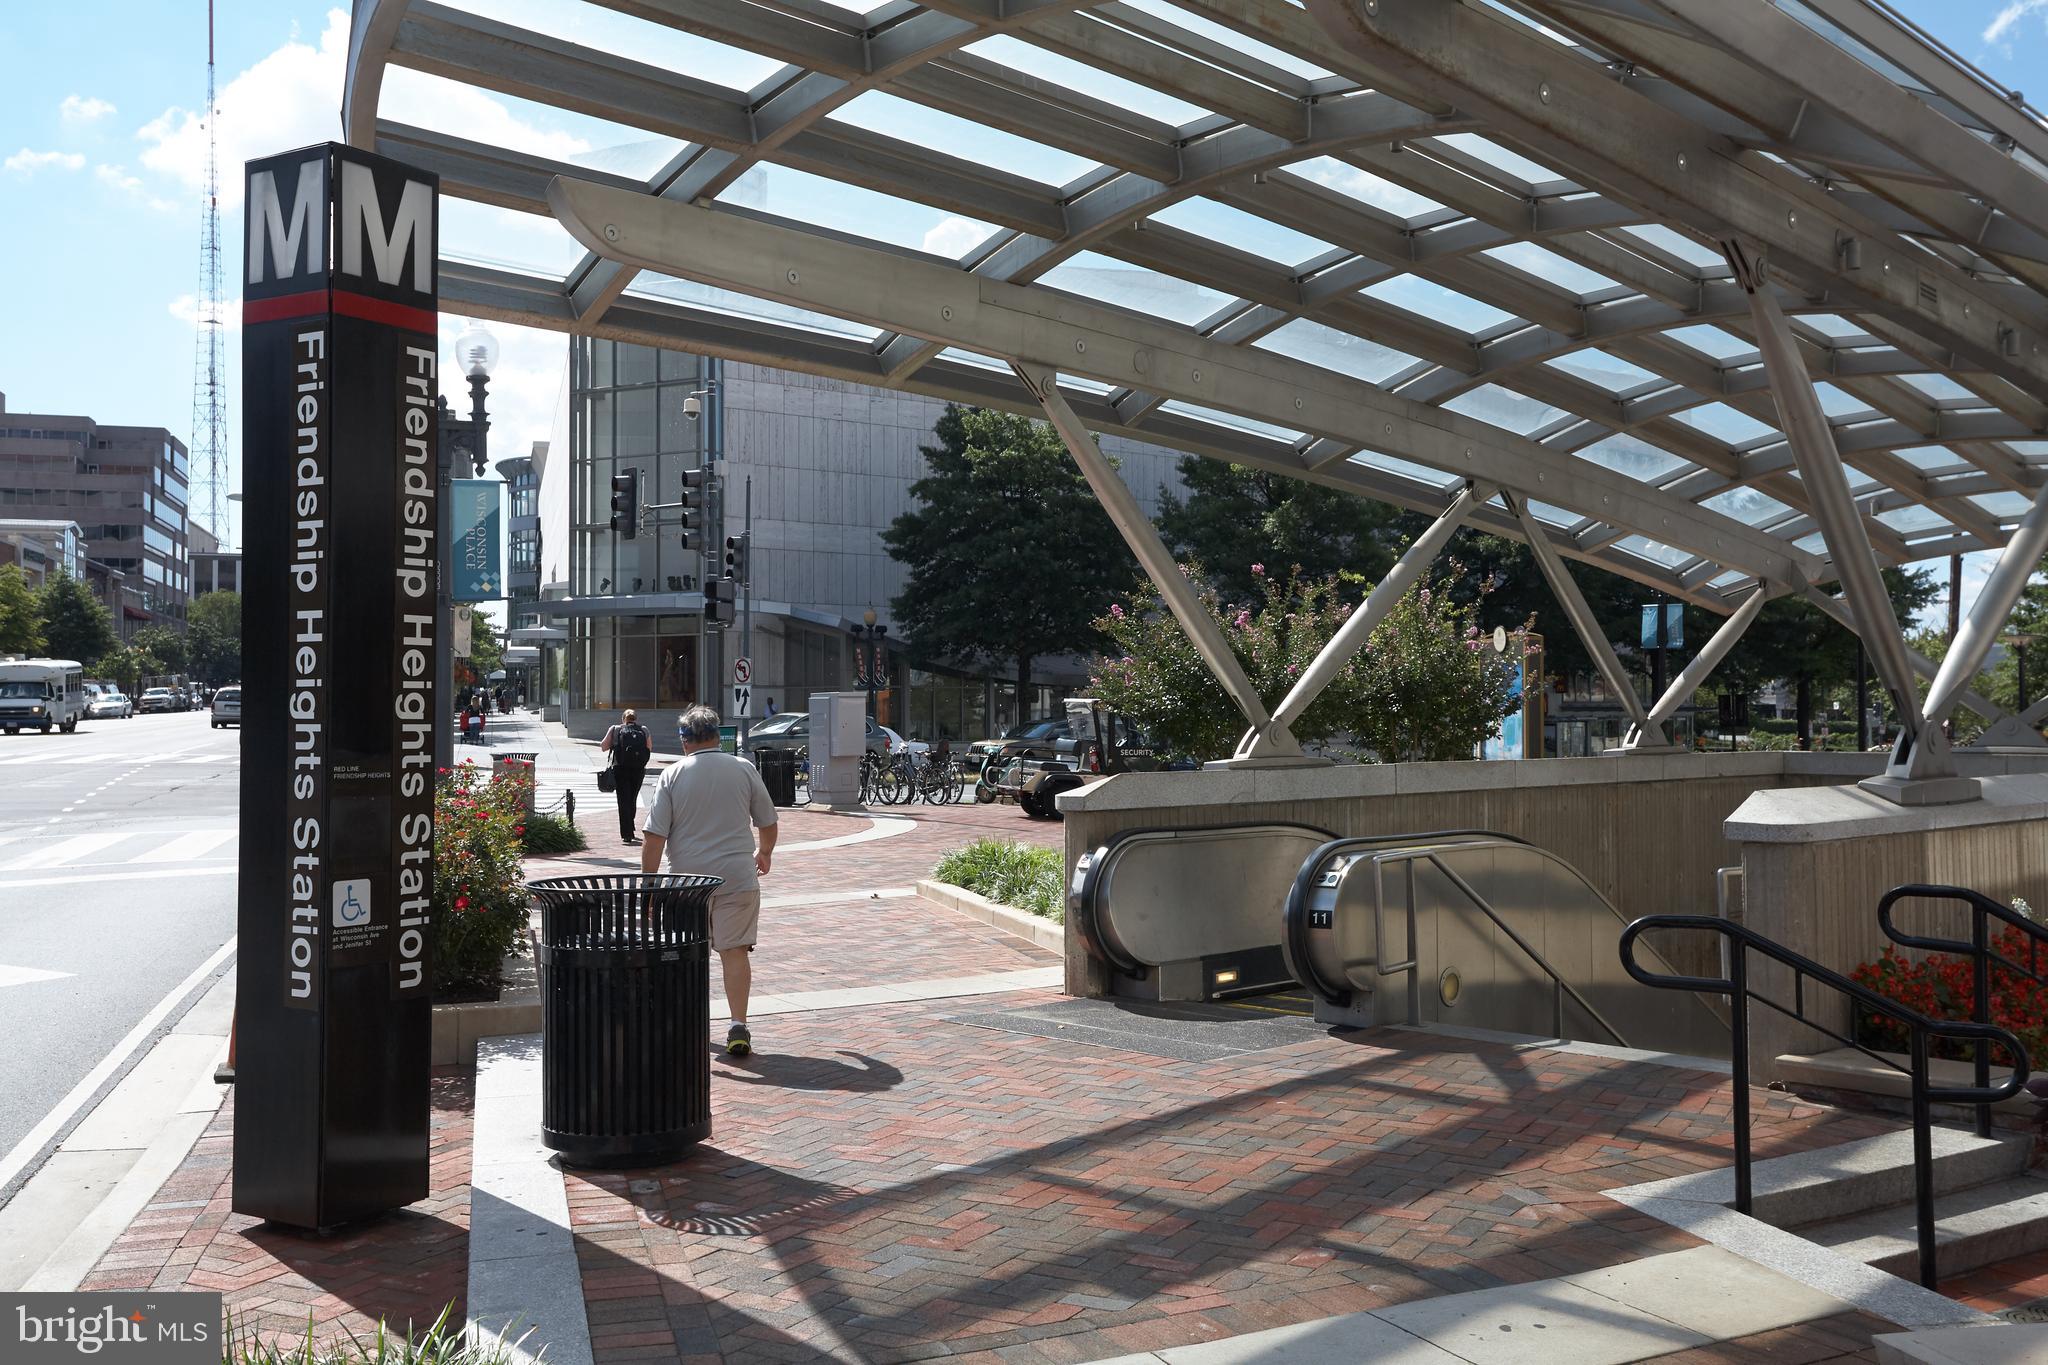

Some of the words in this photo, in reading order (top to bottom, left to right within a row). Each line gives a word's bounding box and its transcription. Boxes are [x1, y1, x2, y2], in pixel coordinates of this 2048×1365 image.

[249, 158, 324, 285] M
[341, 159, 433, 295] M
[290, 330, 325, 593] Friendship
[396, 345, 436, 598] Friendship
[477, 492, 487, 569] WISCONSIN
[466, 528, 476, 569] PLACE
[289, 609, 323, 800] Heights
[395, 614, 433, 798] Heights
[1120, 749, 1154, 757] SECURITY
[290, 816, 320, 998] Station
[399, 813, 431, 989] Station
[1312, 912, 1327, 925] 11
